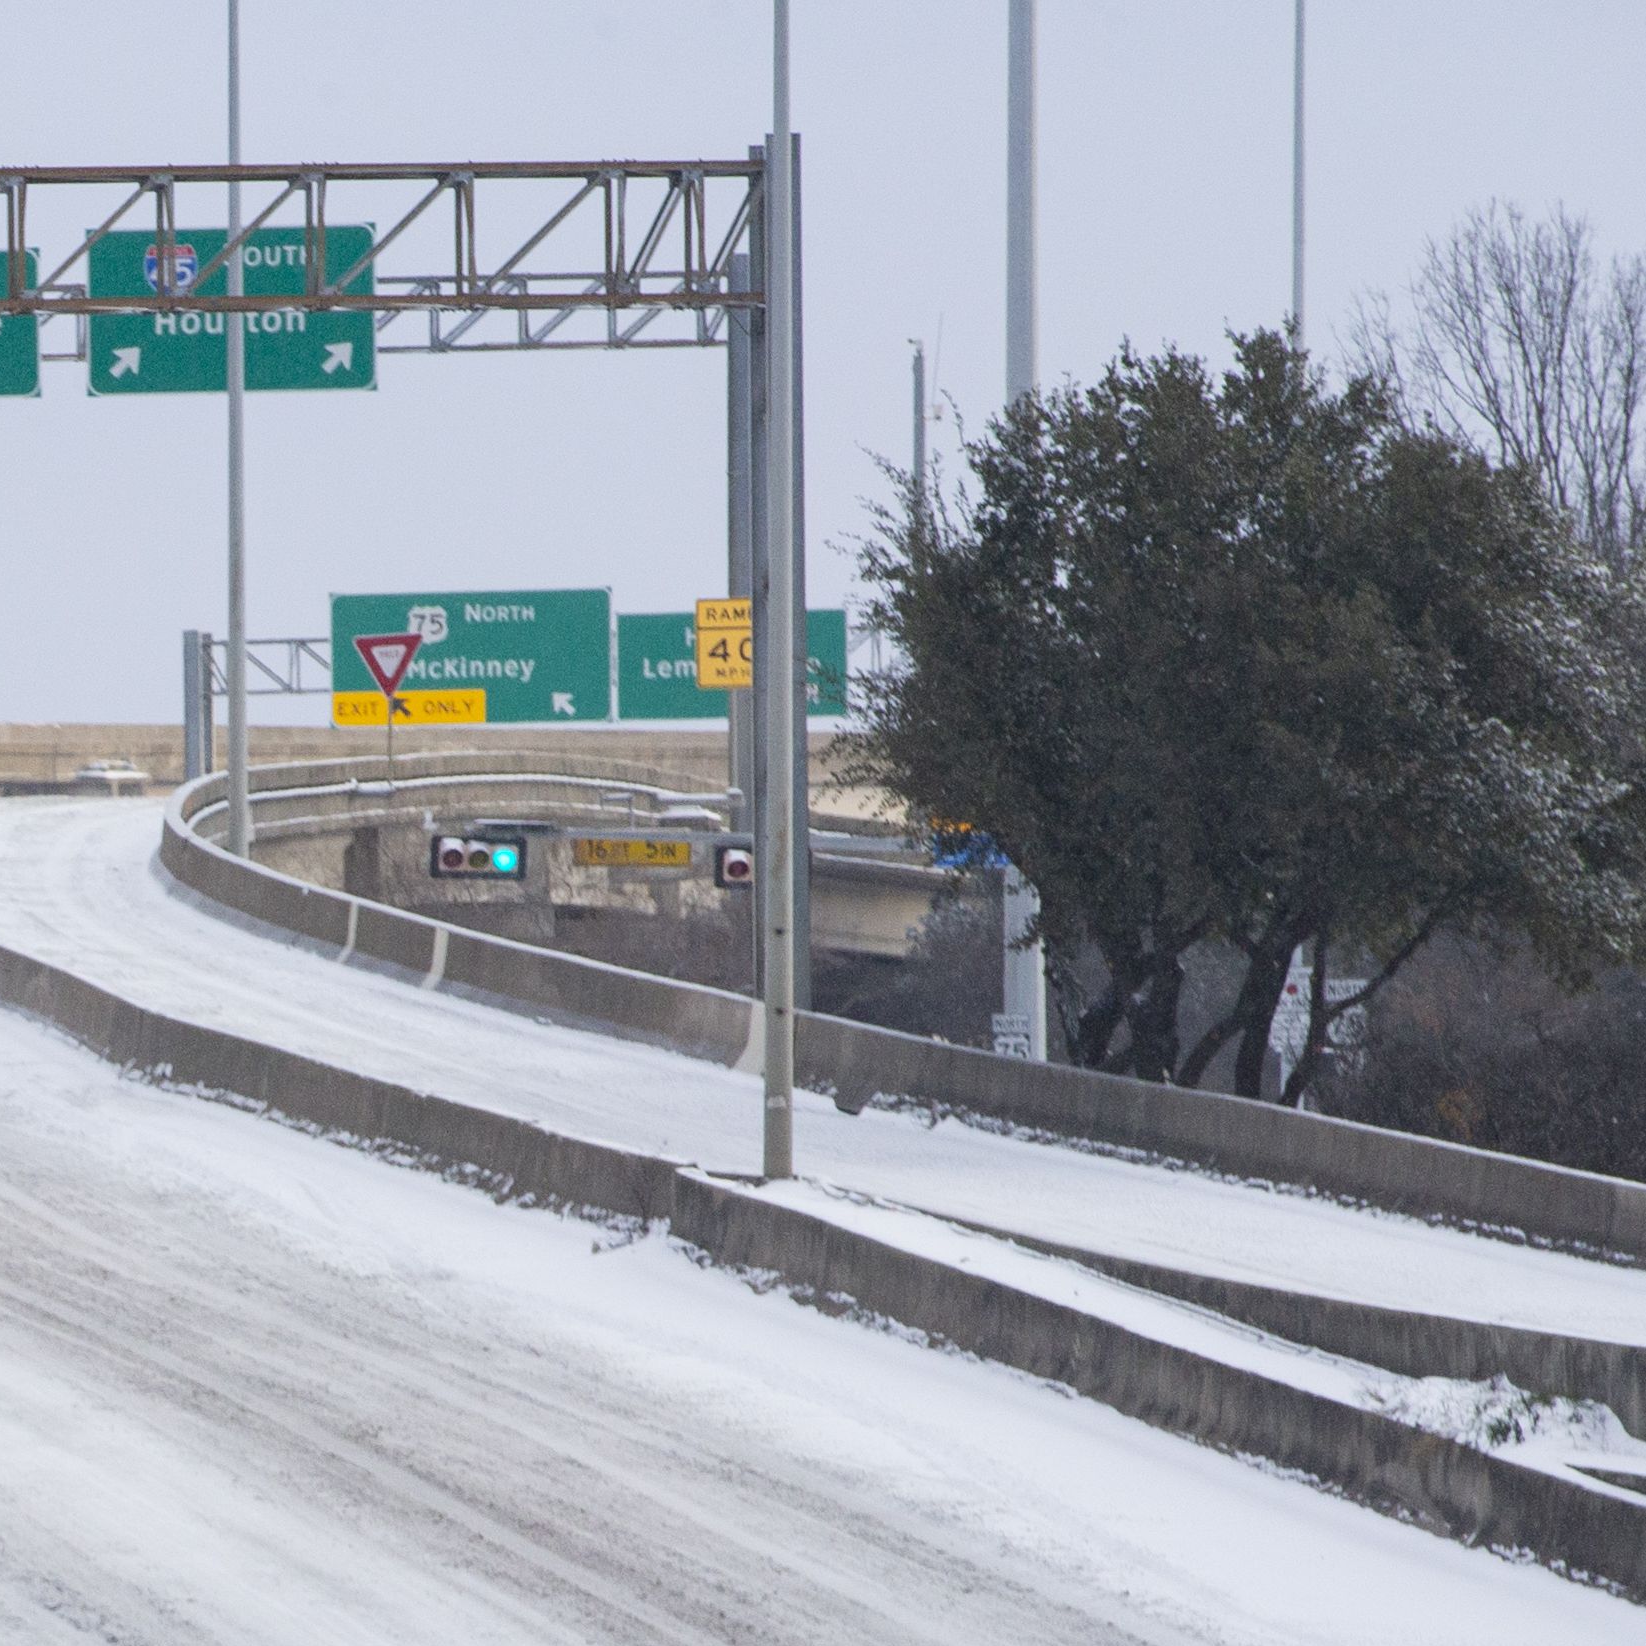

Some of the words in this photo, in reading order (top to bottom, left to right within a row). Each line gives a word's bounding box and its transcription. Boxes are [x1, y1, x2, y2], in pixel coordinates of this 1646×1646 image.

[155, 311, 306, 336] Houton
[412, 613, 444, 636] 75
[464, 603, 536, 623] NORTH
[407, 656, 535, 683] McKinney
[338, 701, 379, 717] EXIT
[423, 700, 474, 716] ONLY
